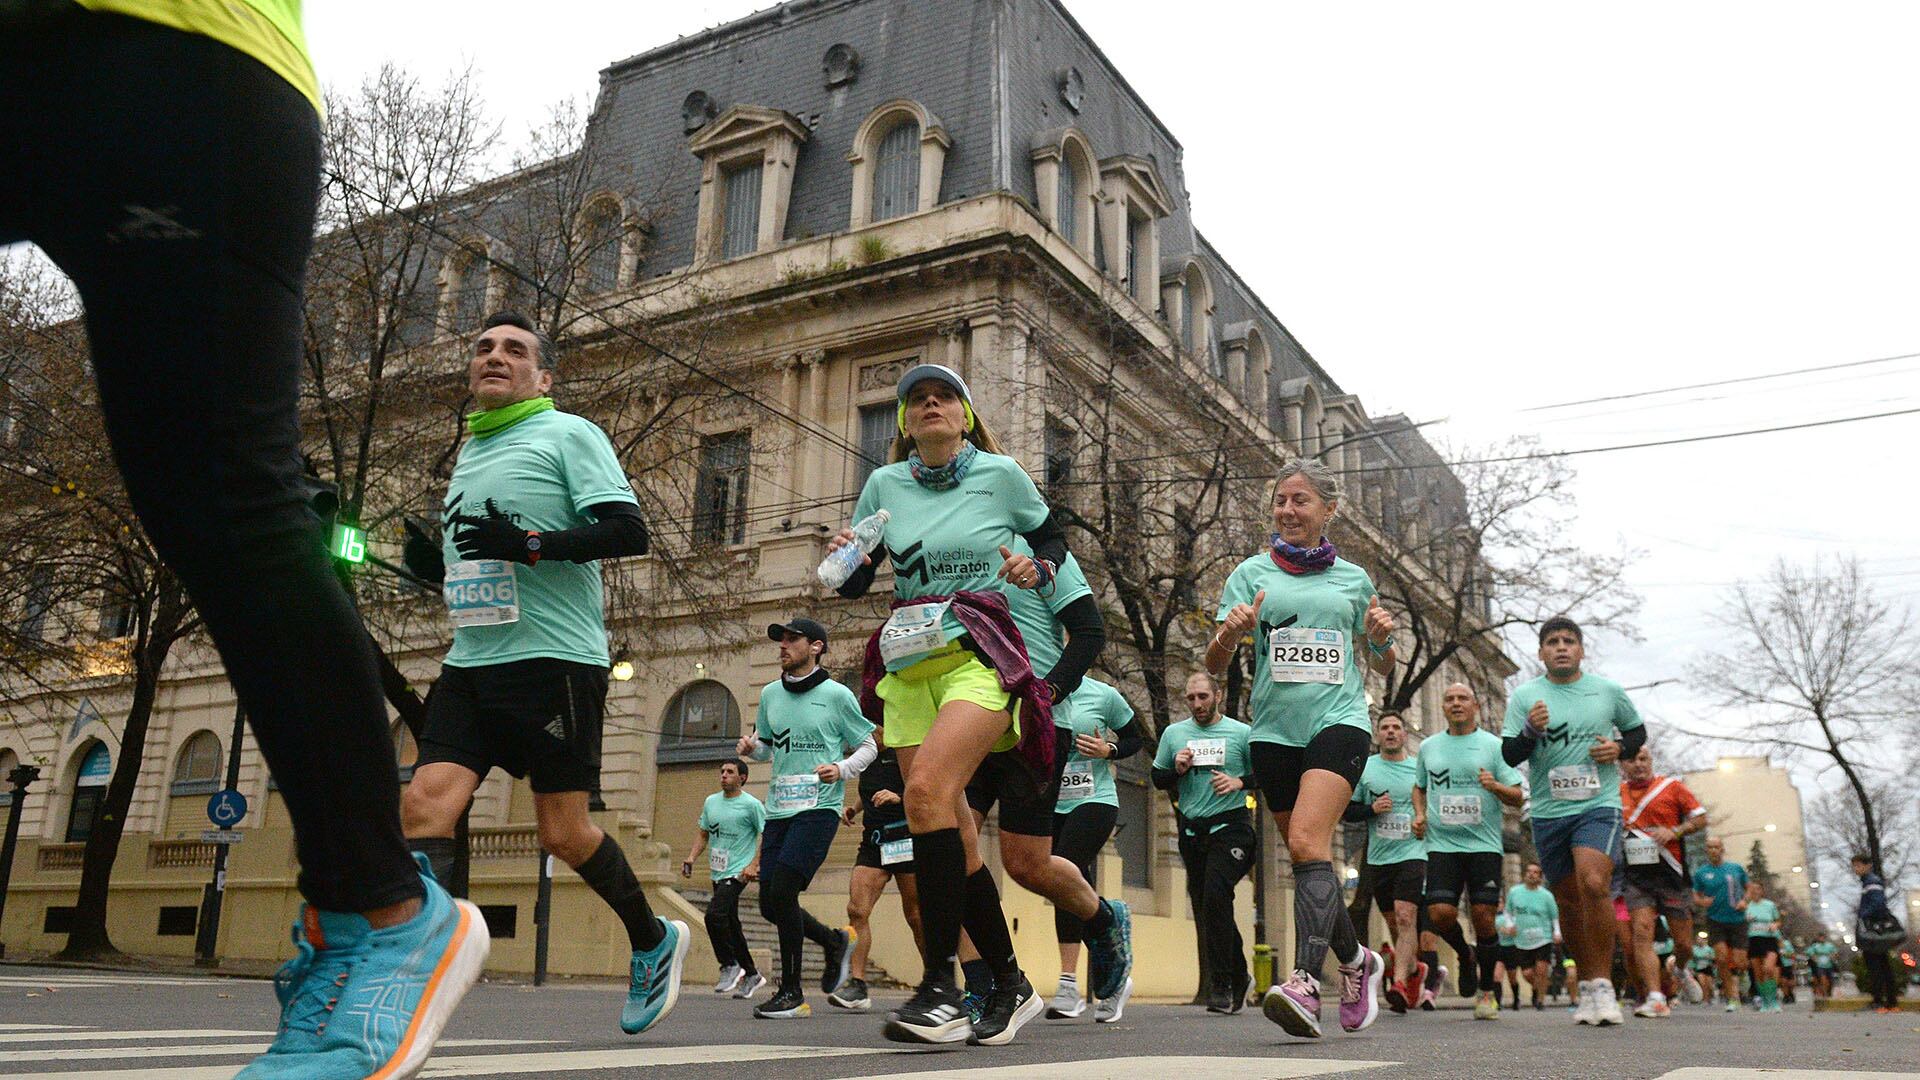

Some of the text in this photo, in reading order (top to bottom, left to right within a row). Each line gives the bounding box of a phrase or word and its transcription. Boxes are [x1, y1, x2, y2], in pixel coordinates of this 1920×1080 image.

[341, 527, 365, 563] 16
[927, 547, 975, 563] Media
[930, 560, 990, 575] Maratón
[1274, 646, 1340, 664] R2889
[792, 742, 825, 750] Maratón
[1060, 774, 1091, 787] 984
[1551, 775, 1597, 789] R2674
[1442, 804, 1480, 815] R2389
